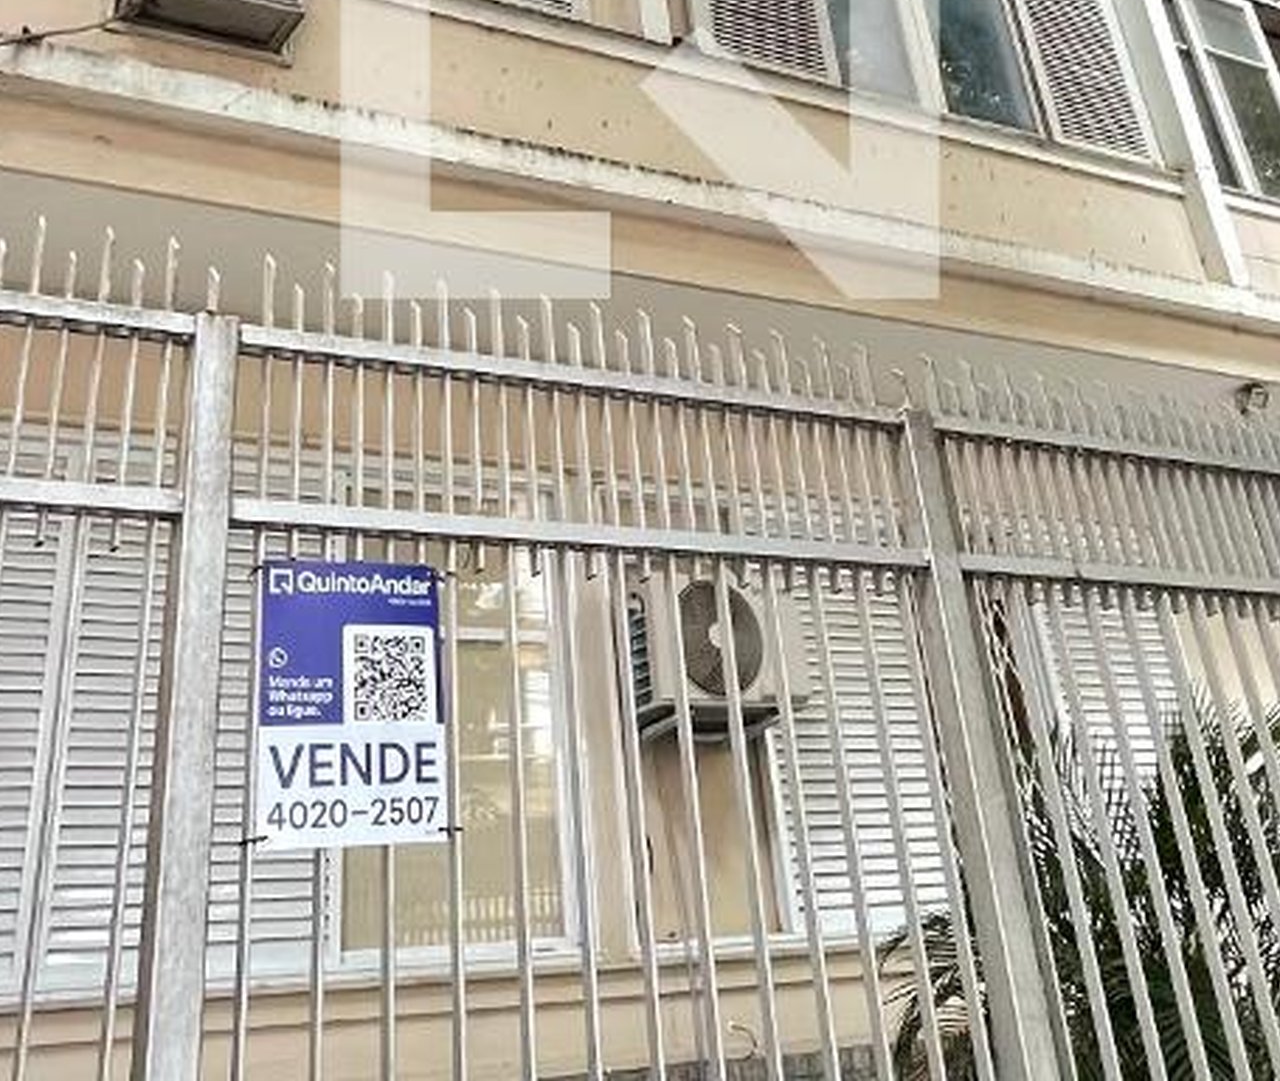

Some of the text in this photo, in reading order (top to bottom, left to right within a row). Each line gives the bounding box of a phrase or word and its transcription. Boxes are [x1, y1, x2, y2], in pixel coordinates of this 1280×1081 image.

[297, 571, 431, 595] QuintoAndar
[268, 742, 439, 789] VENDE
[267, 796, 439, 831] 4020-2507
